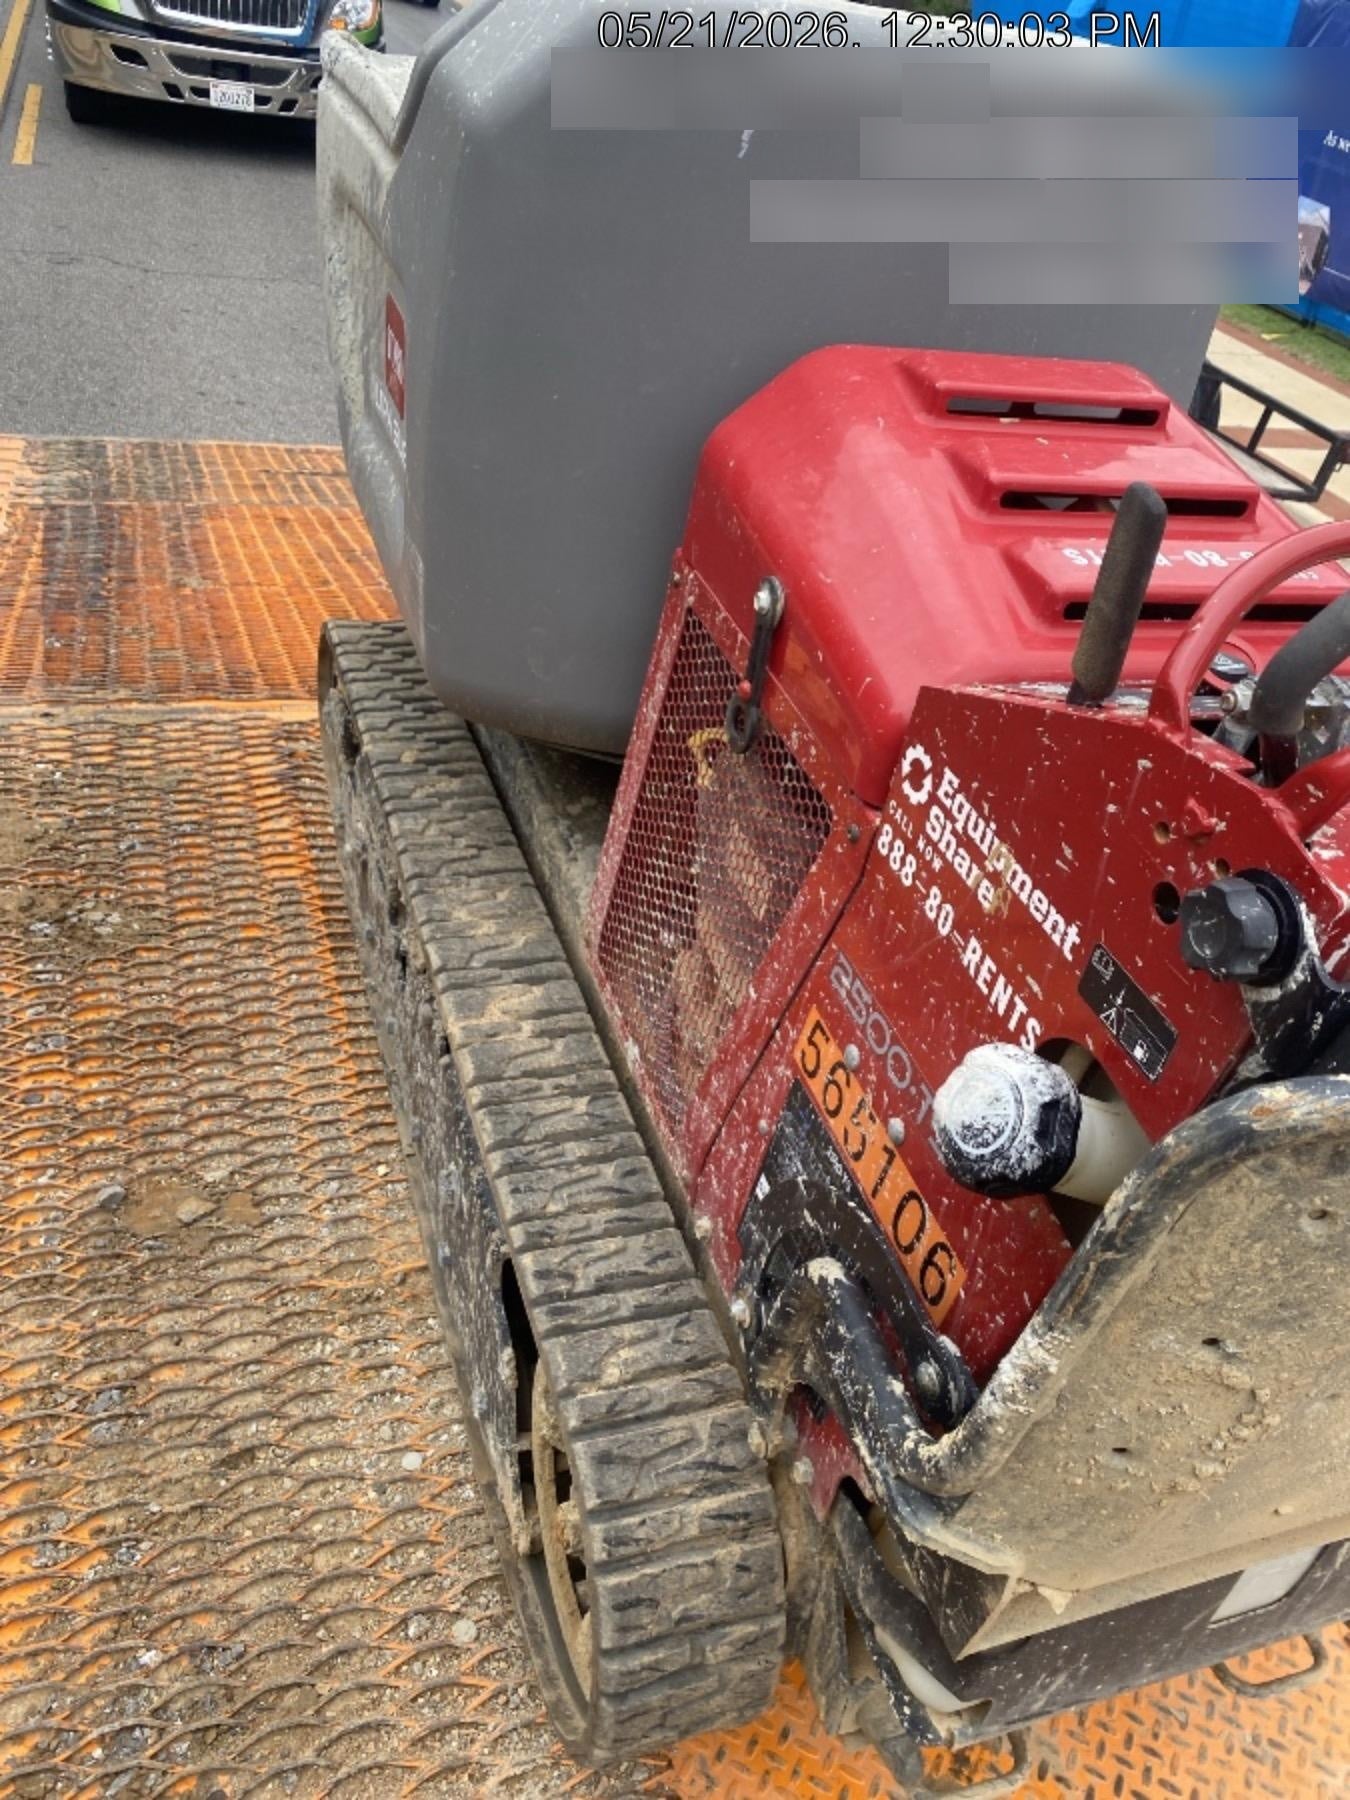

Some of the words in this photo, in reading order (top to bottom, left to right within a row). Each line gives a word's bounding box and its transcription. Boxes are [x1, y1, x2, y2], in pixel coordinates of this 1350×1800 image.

[888, 799, 914, 838] CALL
[917, 833, 944, 873] NOW
[925, 805, 996, 909] Share
[936, 766, 1082, 962] Equipment
[877, 823, 1042, 1053] 888-80-RENTS
[800, 1019, 954, 1306] 565106
